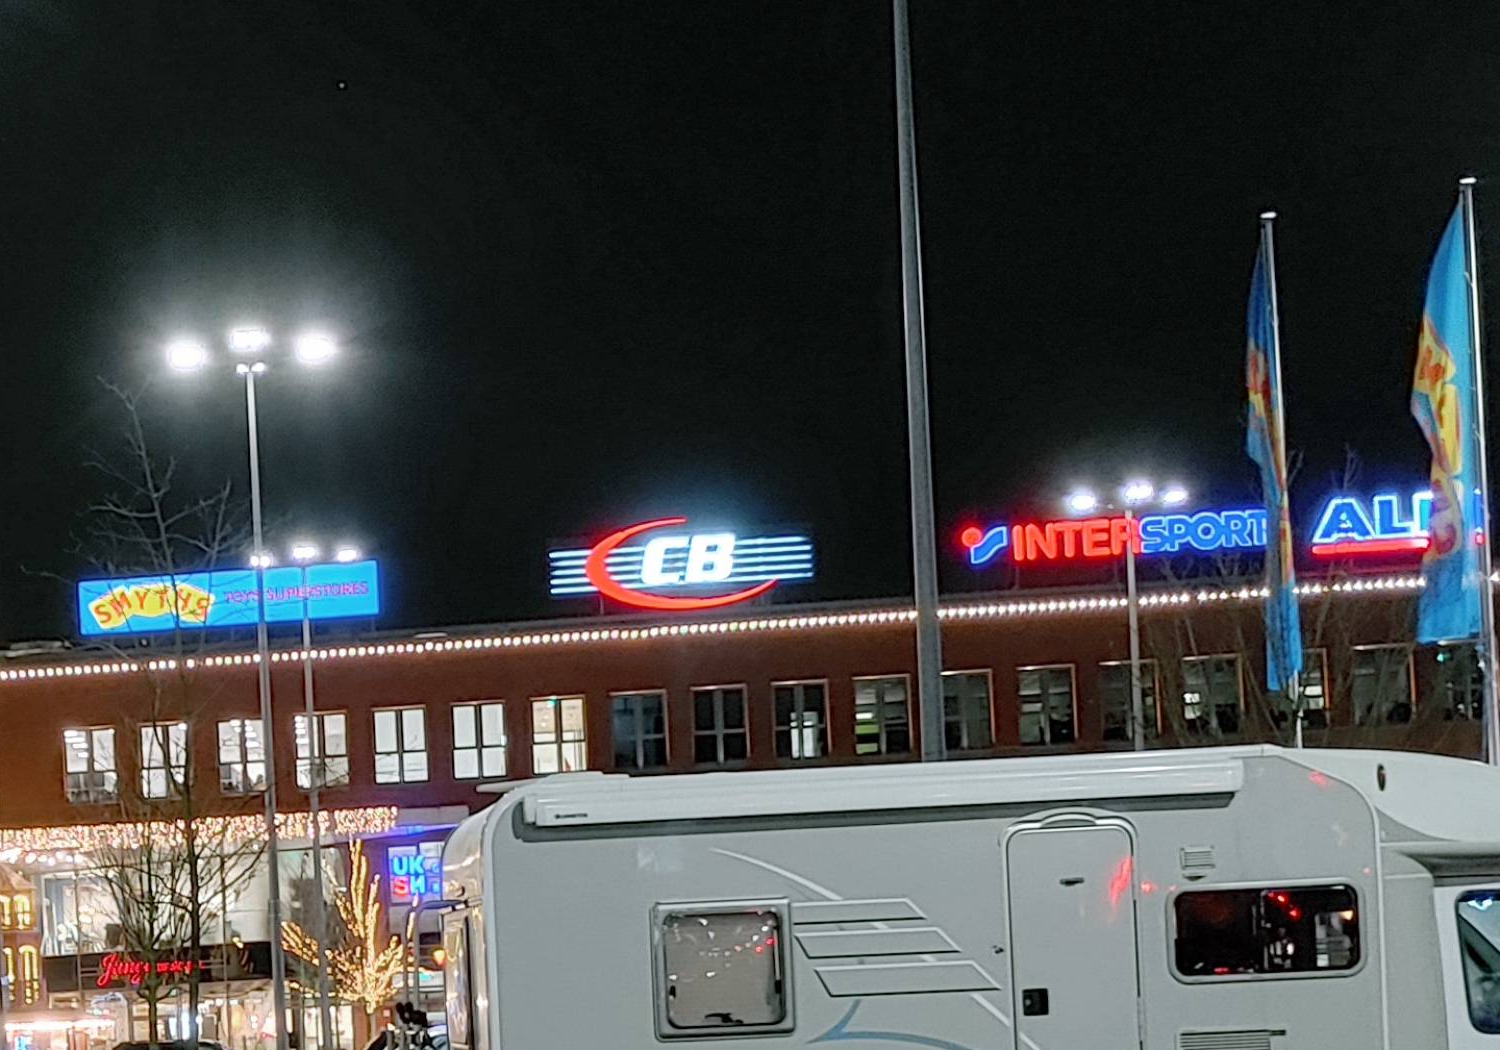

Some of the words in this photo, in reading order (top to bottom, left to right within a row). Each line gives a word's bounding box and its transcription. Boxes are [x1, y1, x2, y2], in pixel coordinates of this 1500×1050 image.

[1012, 508, 1268, 562] INTERSPORT
[392, 855, 426, 876] UK
[393, 875, 426, 897] SH
